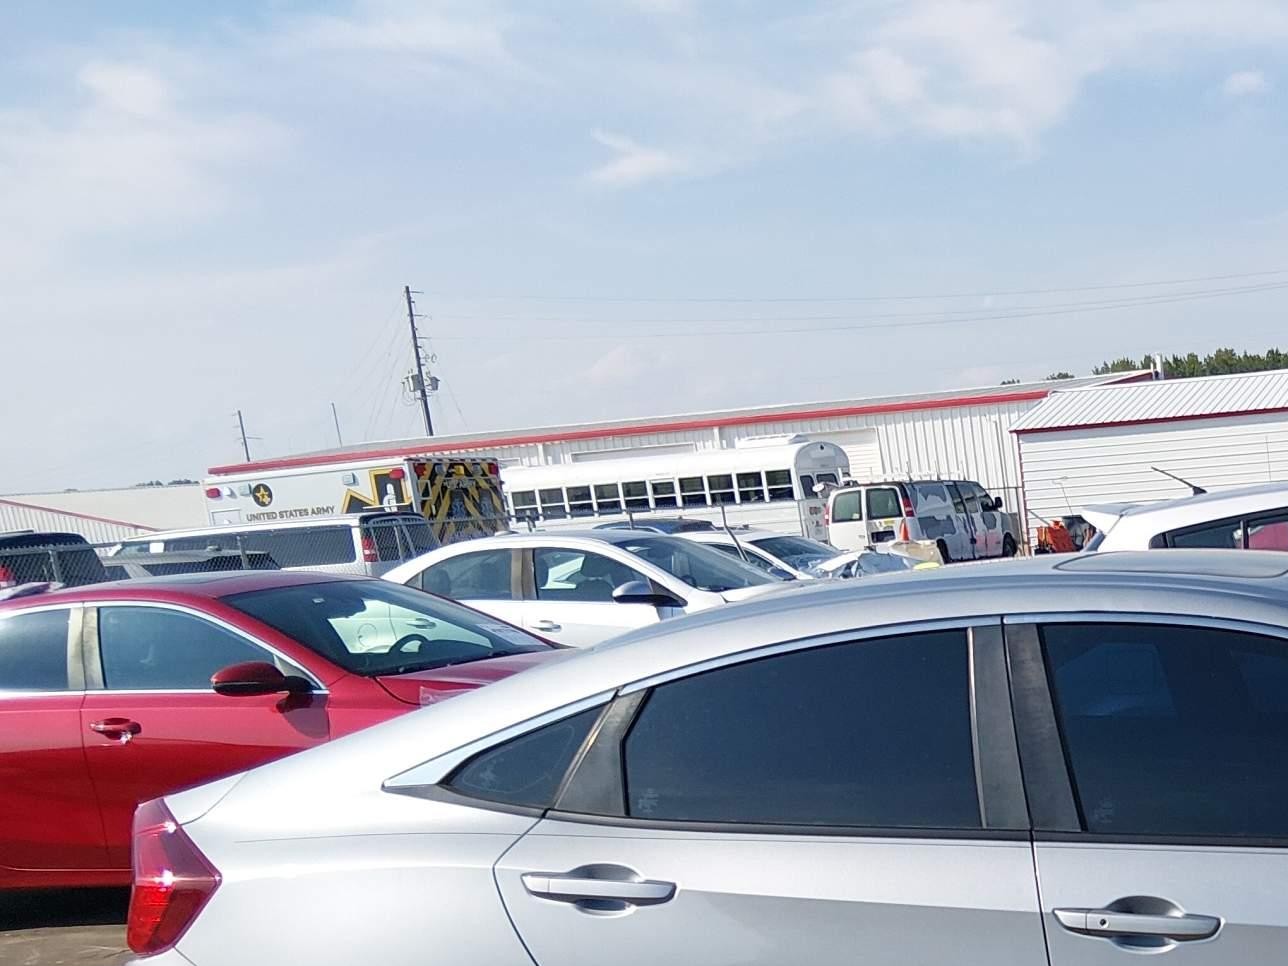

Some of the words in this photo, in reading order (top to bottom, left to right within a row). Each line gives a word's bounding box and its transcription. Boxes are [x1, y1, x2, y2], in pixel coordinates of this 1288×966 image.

[246, 512, 278, 522] UNITED
[279, 508, 309, 518] STATES
[311, 506, 335, 516] ARMY
